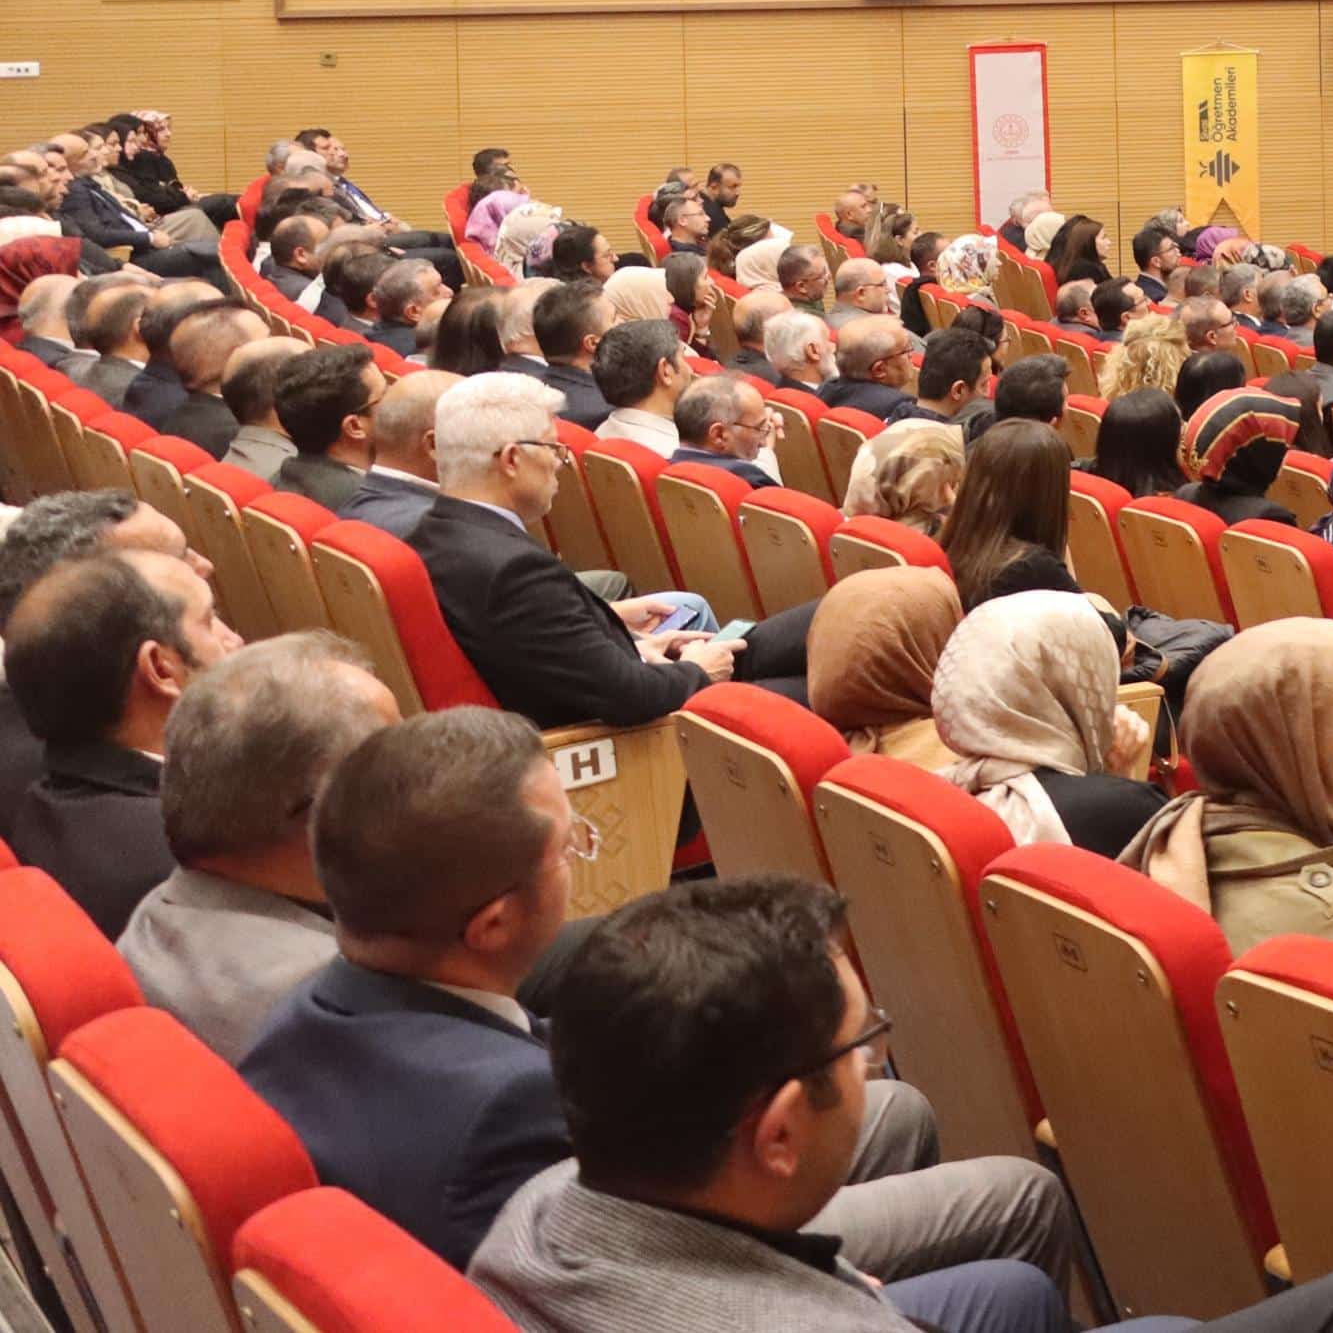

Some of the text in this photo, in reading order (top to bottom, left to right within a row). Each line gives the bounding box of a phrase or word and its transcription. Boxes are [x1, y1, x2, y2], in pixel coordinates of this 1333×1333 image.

[1211, 77, 1226, 143] Öğretmen
[1225, 66, 1237, 142] Akademileri
[571, 746, 601, 782] H
